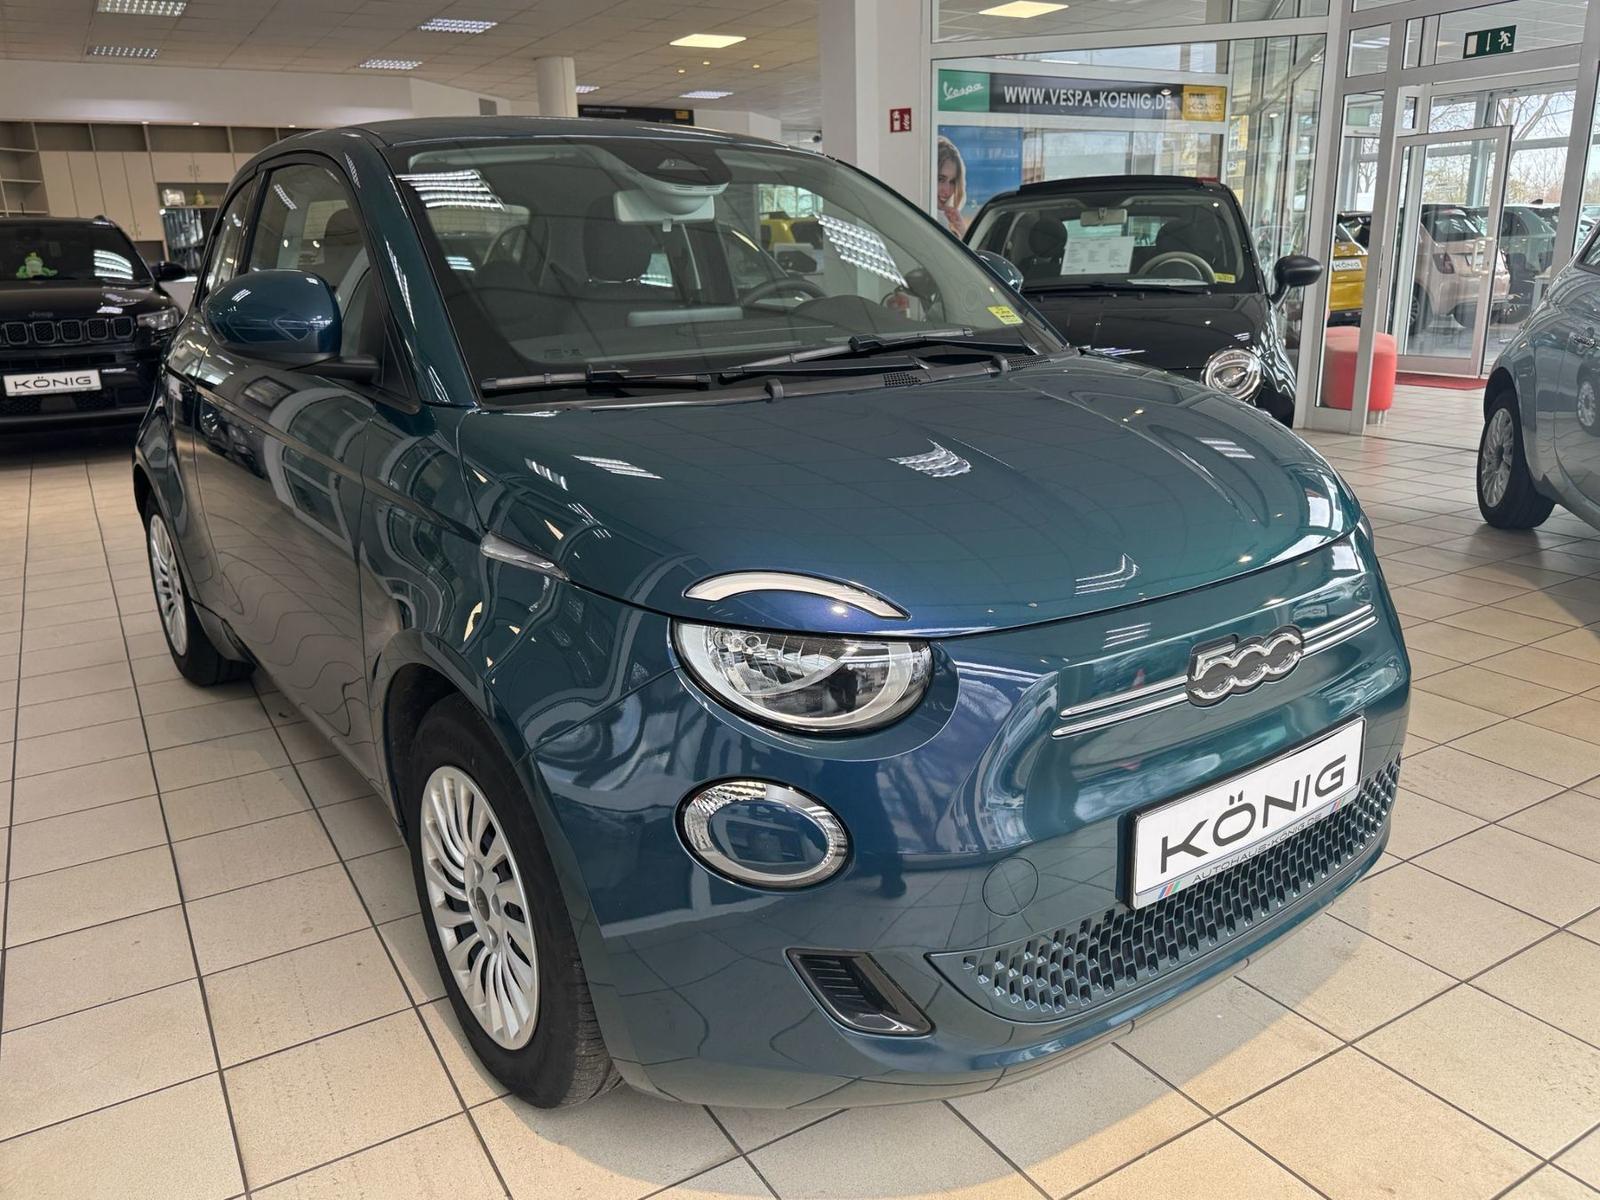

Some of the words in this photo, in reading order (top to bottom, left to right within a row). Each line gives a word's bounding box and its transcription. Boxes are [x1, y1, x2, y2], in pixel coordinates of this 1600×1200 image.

[943, 81, 984, 101] Vespa
[1003, 85, 1172, 110] WWW.VESPA-KOENIG.DE
[14, 376, 91, 389] KÖNIG
[1191, 633, 1300, 699] 500
[1160, 754, 1346, 874] KÖNIG
